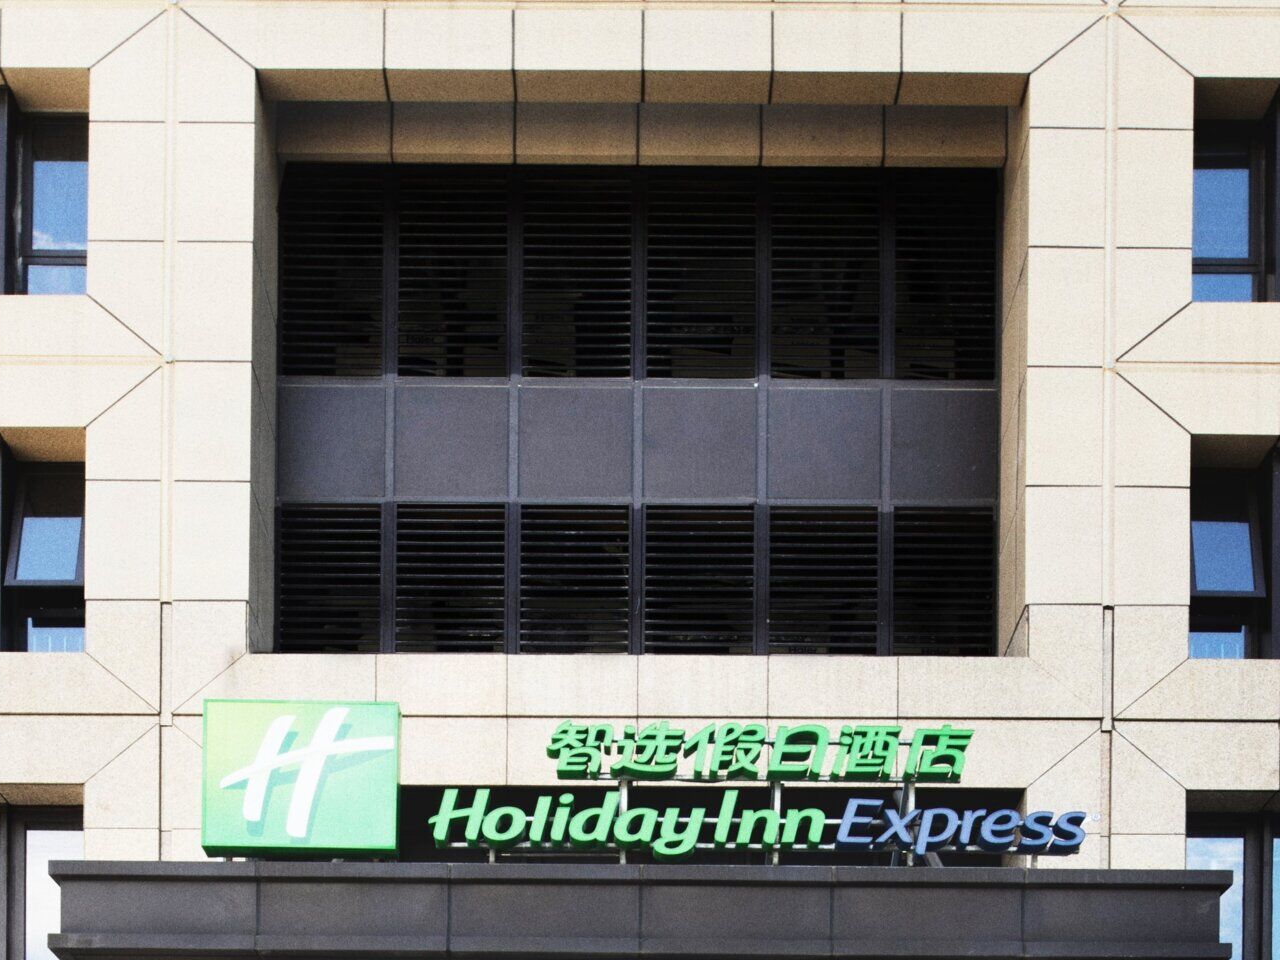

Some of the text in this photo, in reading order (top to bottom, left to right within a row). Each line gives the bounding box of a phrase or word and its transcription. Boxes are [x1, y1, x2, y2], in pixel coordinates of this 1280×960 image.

[547, 719, 974, 781] 智选假日酒店
[427, 788, 1087, 860] Holiday Inn Express
